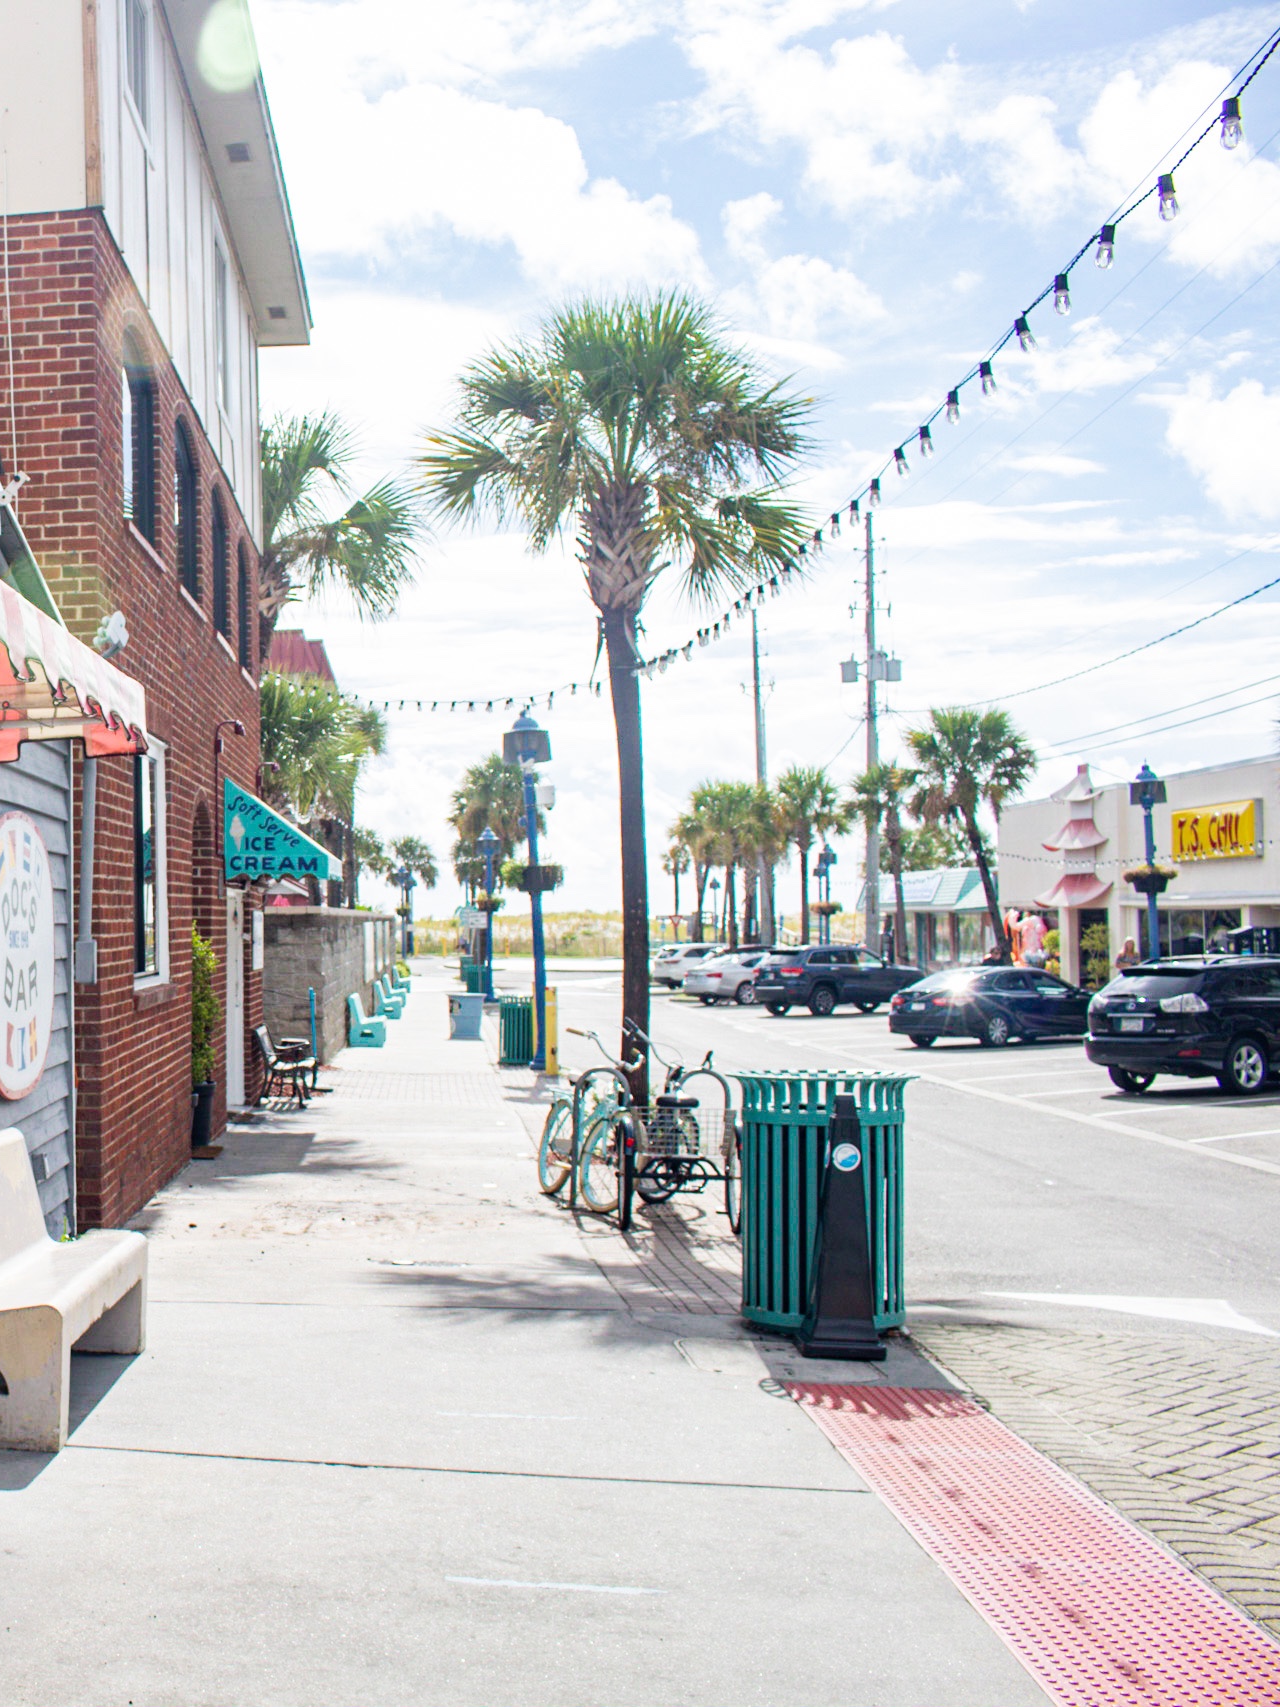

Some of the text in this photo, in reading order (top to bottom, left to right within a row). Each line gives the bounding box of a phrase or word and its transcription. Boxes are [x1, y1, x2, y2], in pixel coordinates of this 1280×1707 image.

[227, 796, 300, 848] Soft Serve
[245, 837, 276, 851] ICE
[1208, 813, 1239, 850] CHU
[229, 855, 318, 872] CREAM
[1, 877, 37, 935] DOC'S
[4, 957, 38, 1012] BAR
